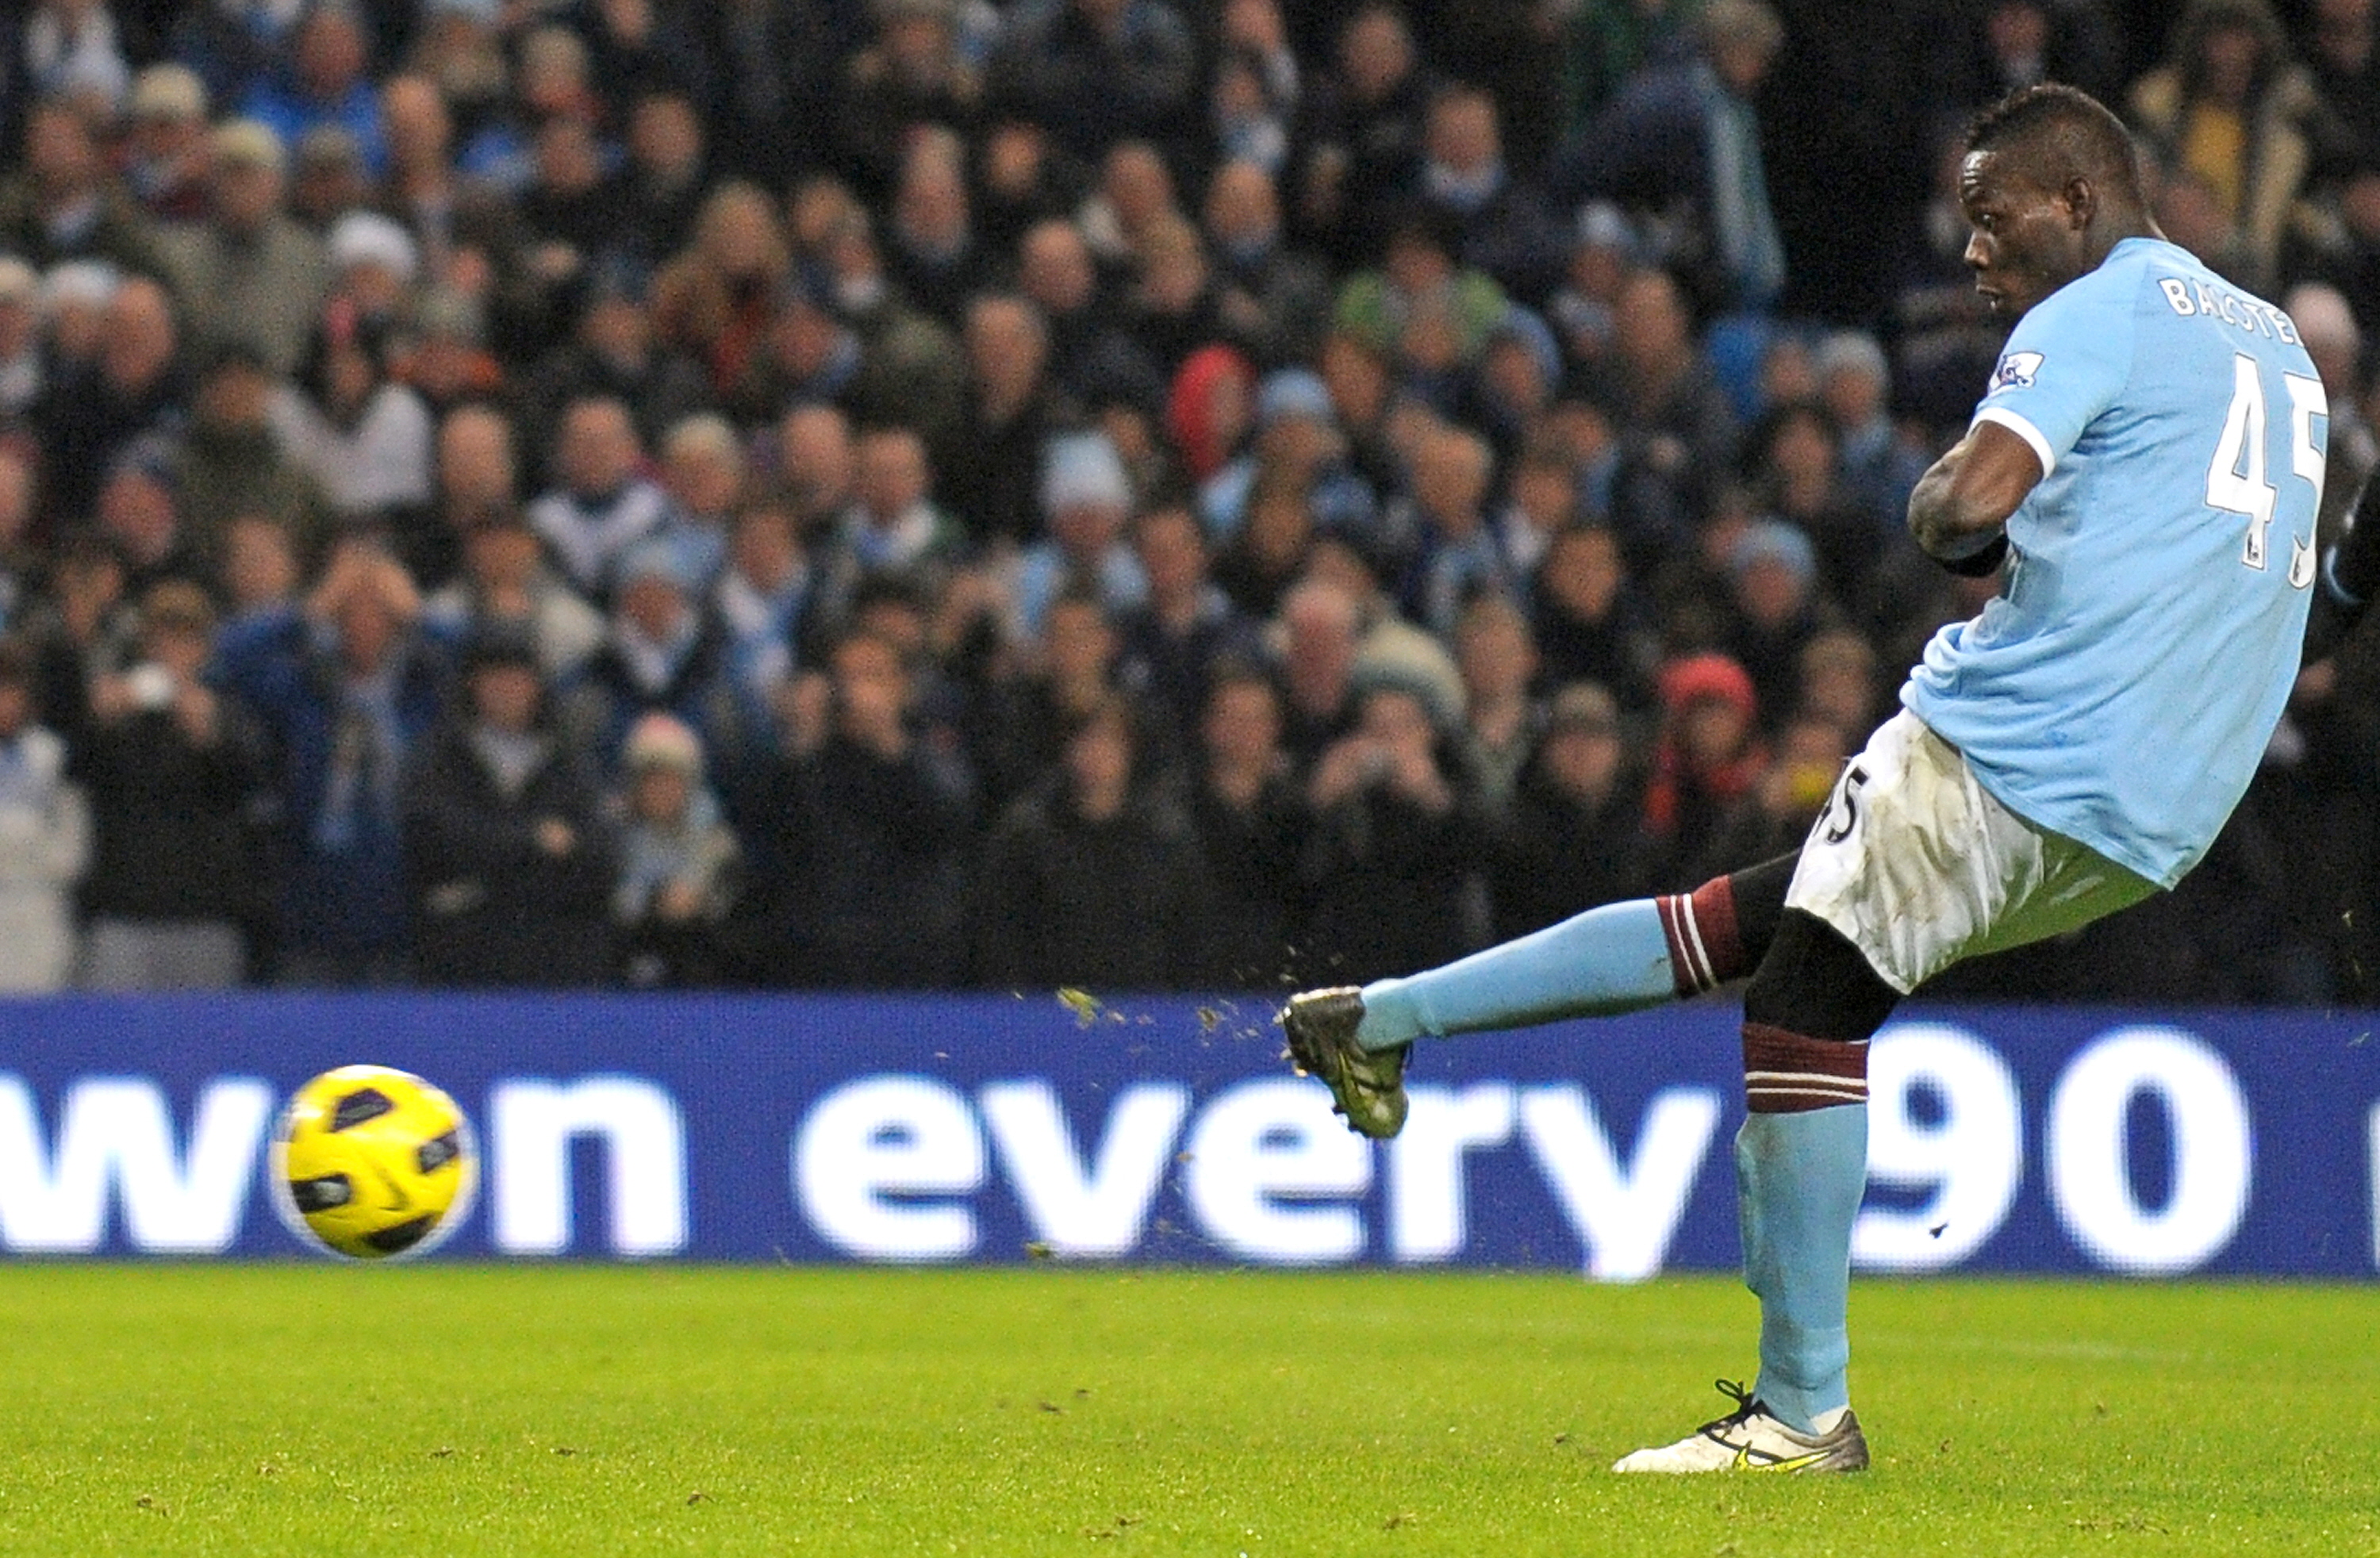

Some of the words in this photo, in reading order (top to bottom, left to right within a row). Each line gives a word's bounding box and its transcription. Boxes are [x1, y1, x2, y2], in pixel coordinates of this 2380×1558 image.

[2206, 352, 2328, 589] 45
[793, 1074, 1722, 1286] every
[1850, 1023, 2253, 1274] 90
